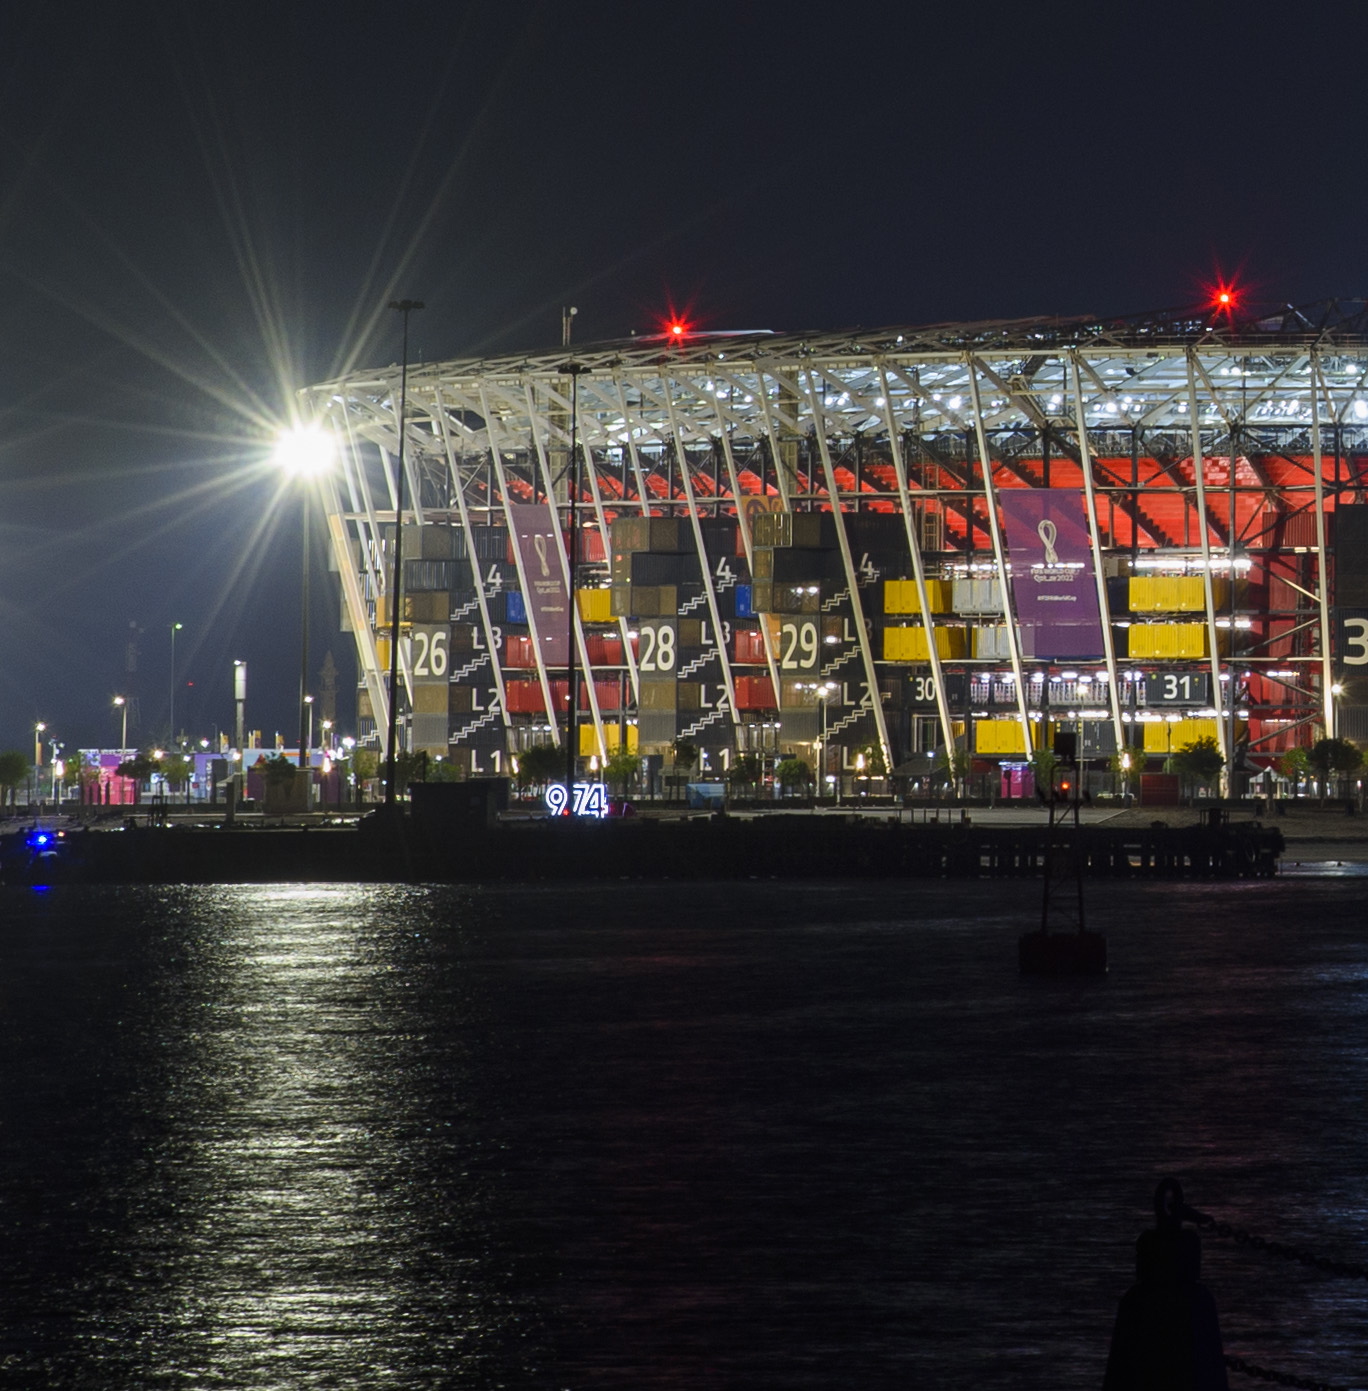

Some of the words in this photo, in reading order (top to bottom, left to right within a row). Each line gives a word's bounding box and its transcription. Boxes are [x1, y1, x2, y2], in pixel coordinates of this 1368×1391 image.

[414, 631, 447, 677] 26
[640, 625, 675, 671] 28
[782, 623, 818, 669] 29
[915, 676, 936, 701] 30
[1163, 674, 1191, 700] 31
[546, 784, 608, 818] 974
